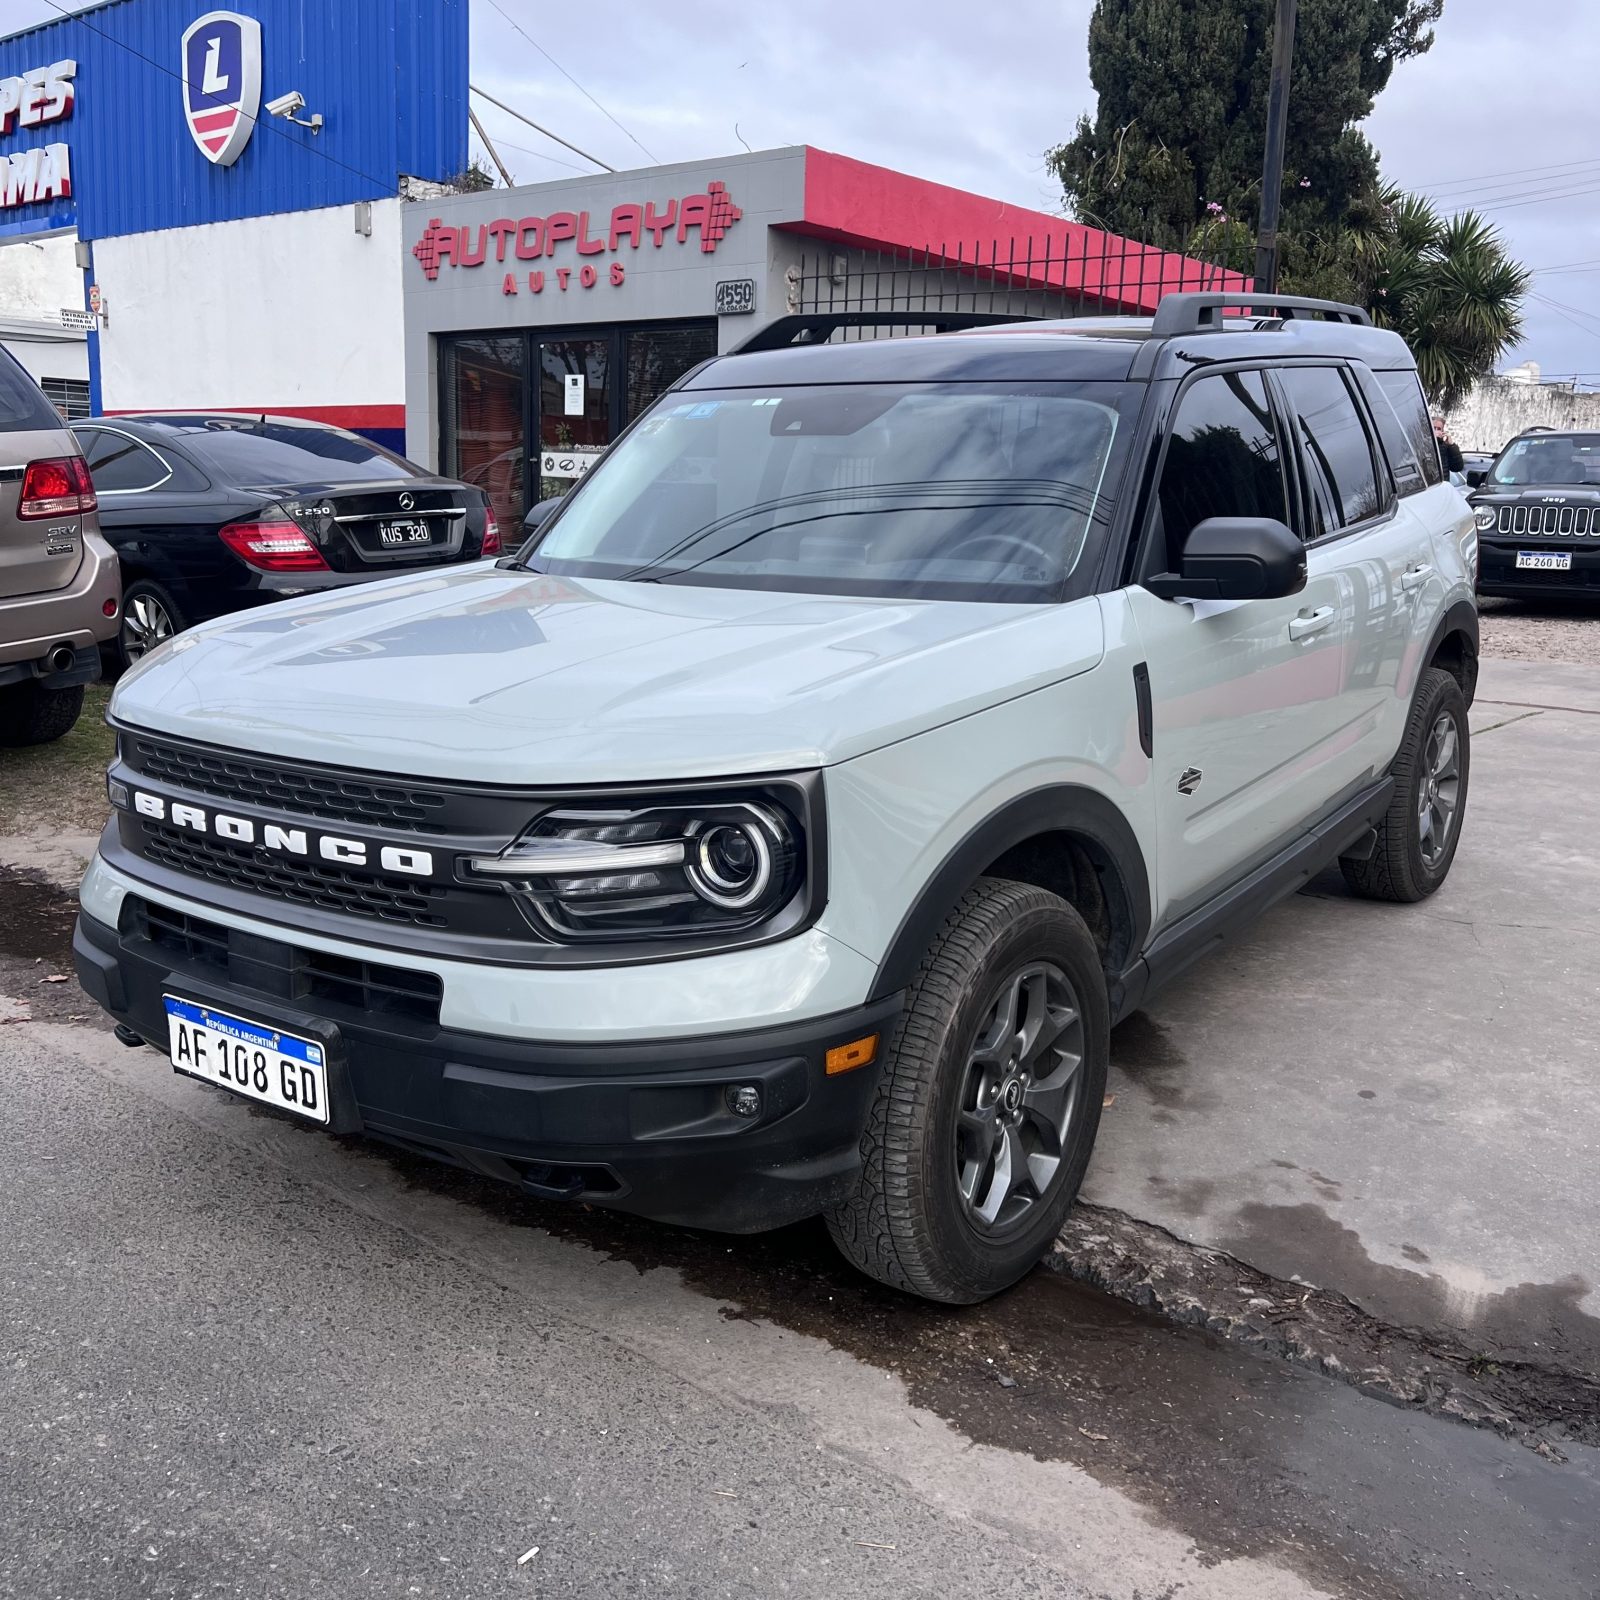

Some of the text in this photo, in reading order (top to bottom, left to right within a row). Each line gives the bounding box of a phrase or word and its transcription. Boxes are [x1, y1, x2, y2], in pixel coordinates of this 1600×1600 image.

[201, 36, 230, 95] L
[433, 193, 714, 267] AUTOPLAYA
[502, 262, 625, 295] AUTOS
[718, 283, 751, 306] 4550
[294, 506, 331, 516] C 250
[380, 524, 429, 543] KUS 320
[1518, 557, 1568, 568] AC 260 VG
[134, 790, 434, 876] BRONCO
[205, 1017, 279, 1051] REPÚBLICA ARGENTINA
[178, 1023, 318, 1110] AF 108 GD
